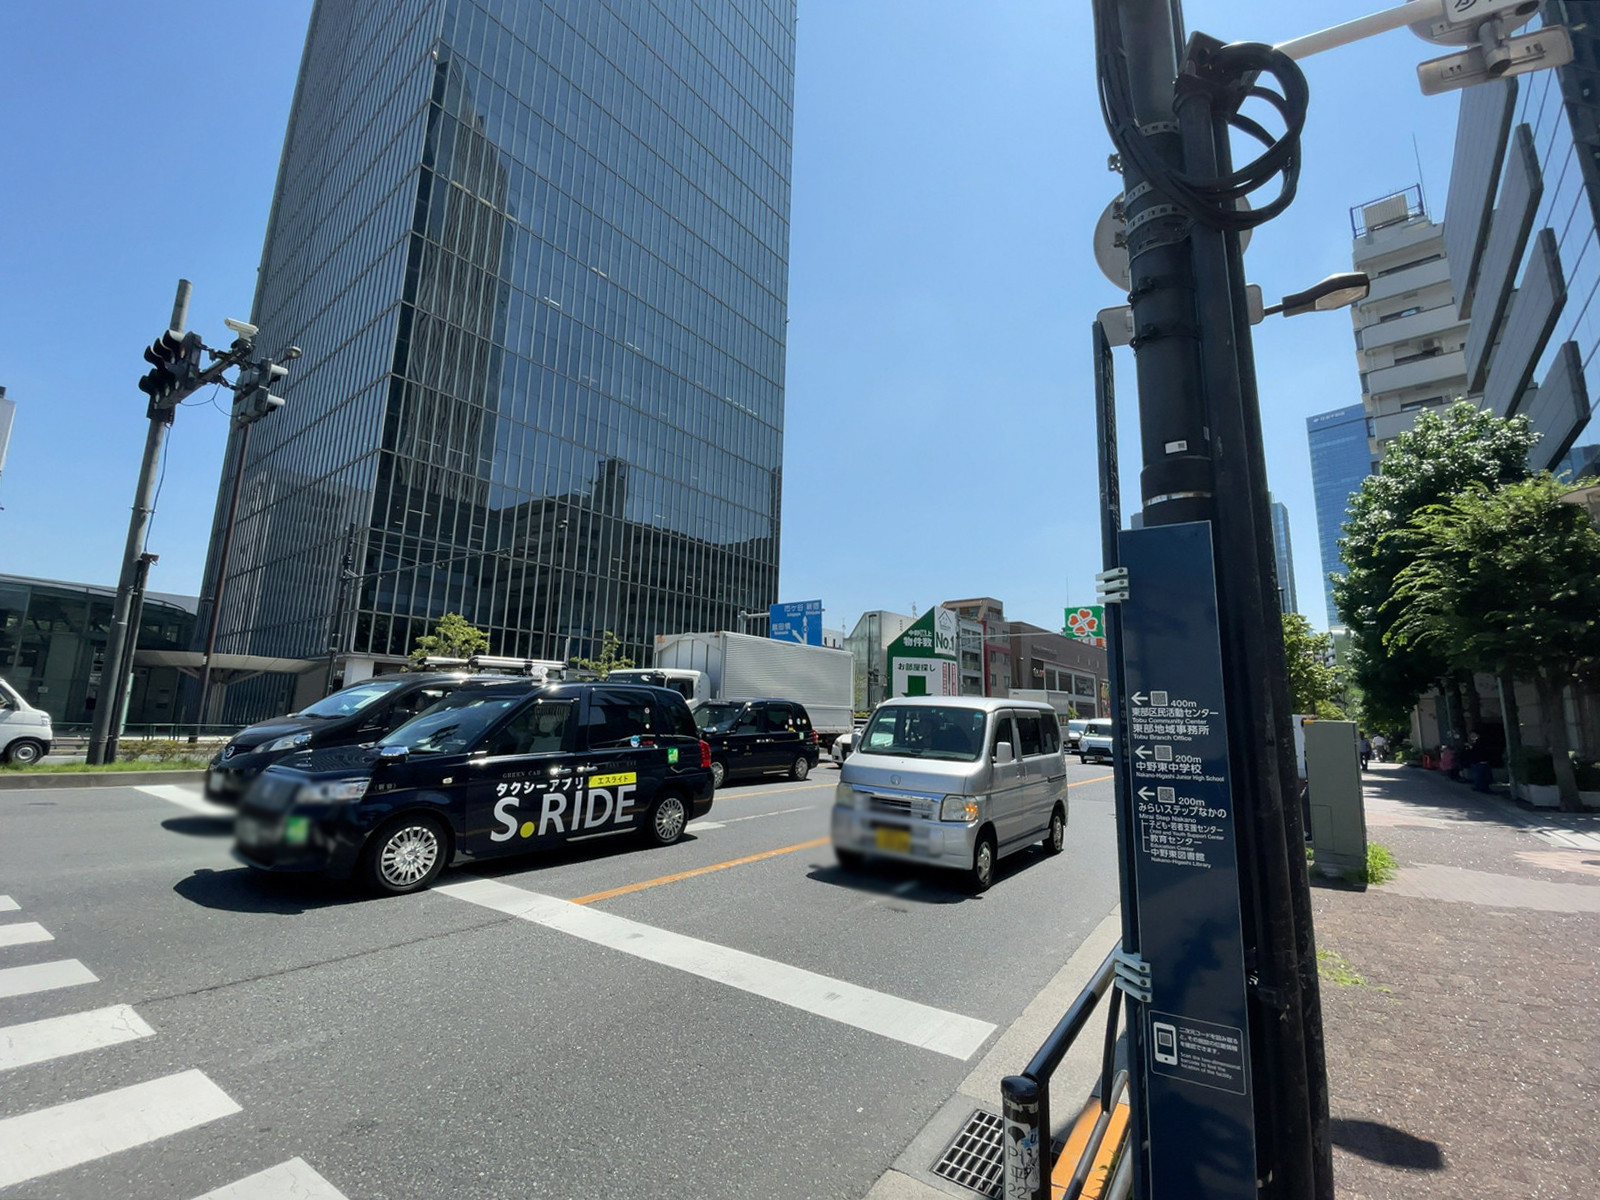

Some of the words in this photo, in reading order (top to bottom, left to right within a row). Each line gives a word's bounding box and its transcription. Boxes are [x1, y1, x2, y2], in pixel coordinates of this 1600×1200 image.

[903, 637, 932, 648] 物件数
[935, 631, 955, 652] No.1
[898, 663, 936, 672] お部屋探し
[1170, 699, 1197, 708] 400m
[1131, 707, 1219, 718] 東部区民活動センター
[1133, 724, 1210, 736] 東部地域事務所
[1149, 734, 1172, 742] Branch
[1175, 754, 1202, 764] 200m
[1135, 761, 1203, 774] 中野東中学校
[1192, 774, 1205, 782] High
[1205, 775, 1225, 783] School
[496, 776, 585, 798] タクシーアプリ
[1178, 797, 1205, 807] 200m
[490, 783, 637, 843] S.RIDE
[1138, 802, 1227, 819] みらいステップなかの
[1155, 814, 1171, 822] Step
[1171, 815, 1197, 823] Nakano
[1149, 820, 1224, 834] 子ども・若者支援センター
[1149, 834, 1203, 846] 教育センター
[1207, 833, 1225, 841] Center
[1149, 843, 1176, 851] Education
[1150, 848, 1206, 862] 中野東図書館
[1192, 861, 1212, 869] Library
